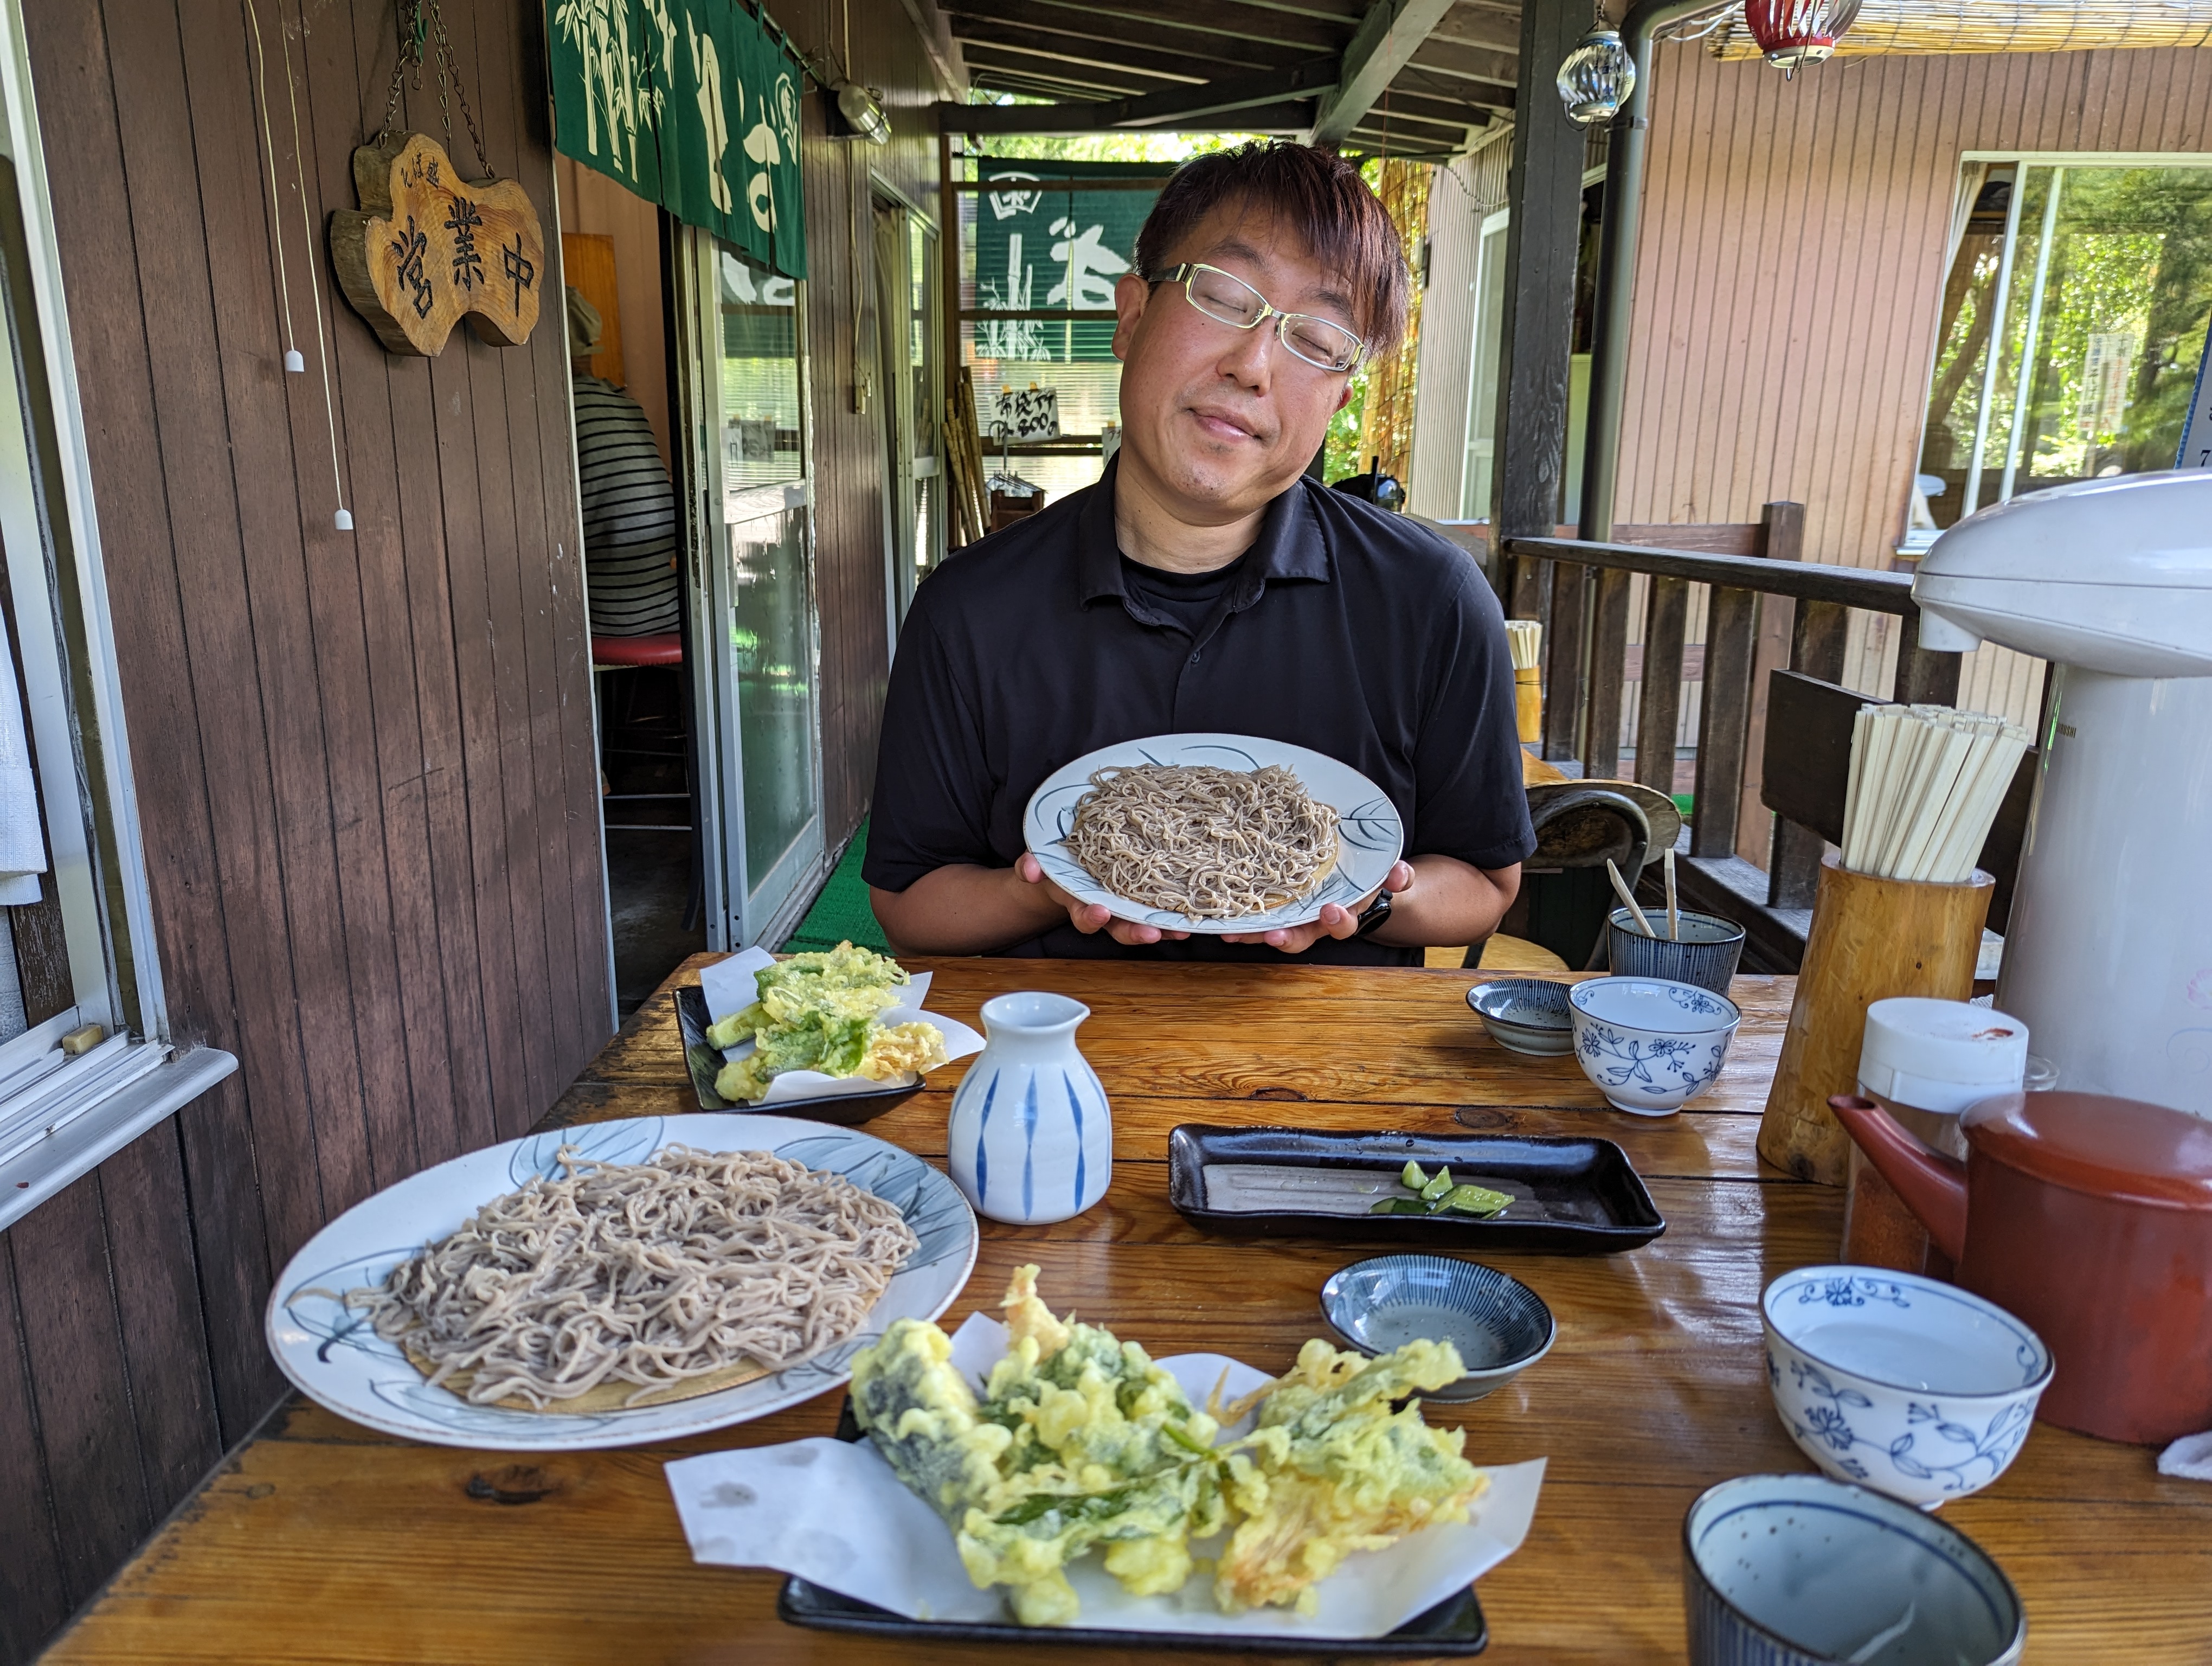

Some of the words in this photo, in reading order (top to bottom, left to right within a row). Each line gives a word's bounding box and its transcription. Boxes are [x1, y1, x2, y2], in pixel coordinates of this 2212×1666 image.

[391, 196, 534, 319] 営業中
[2201, 450, 2211, 467] 7
